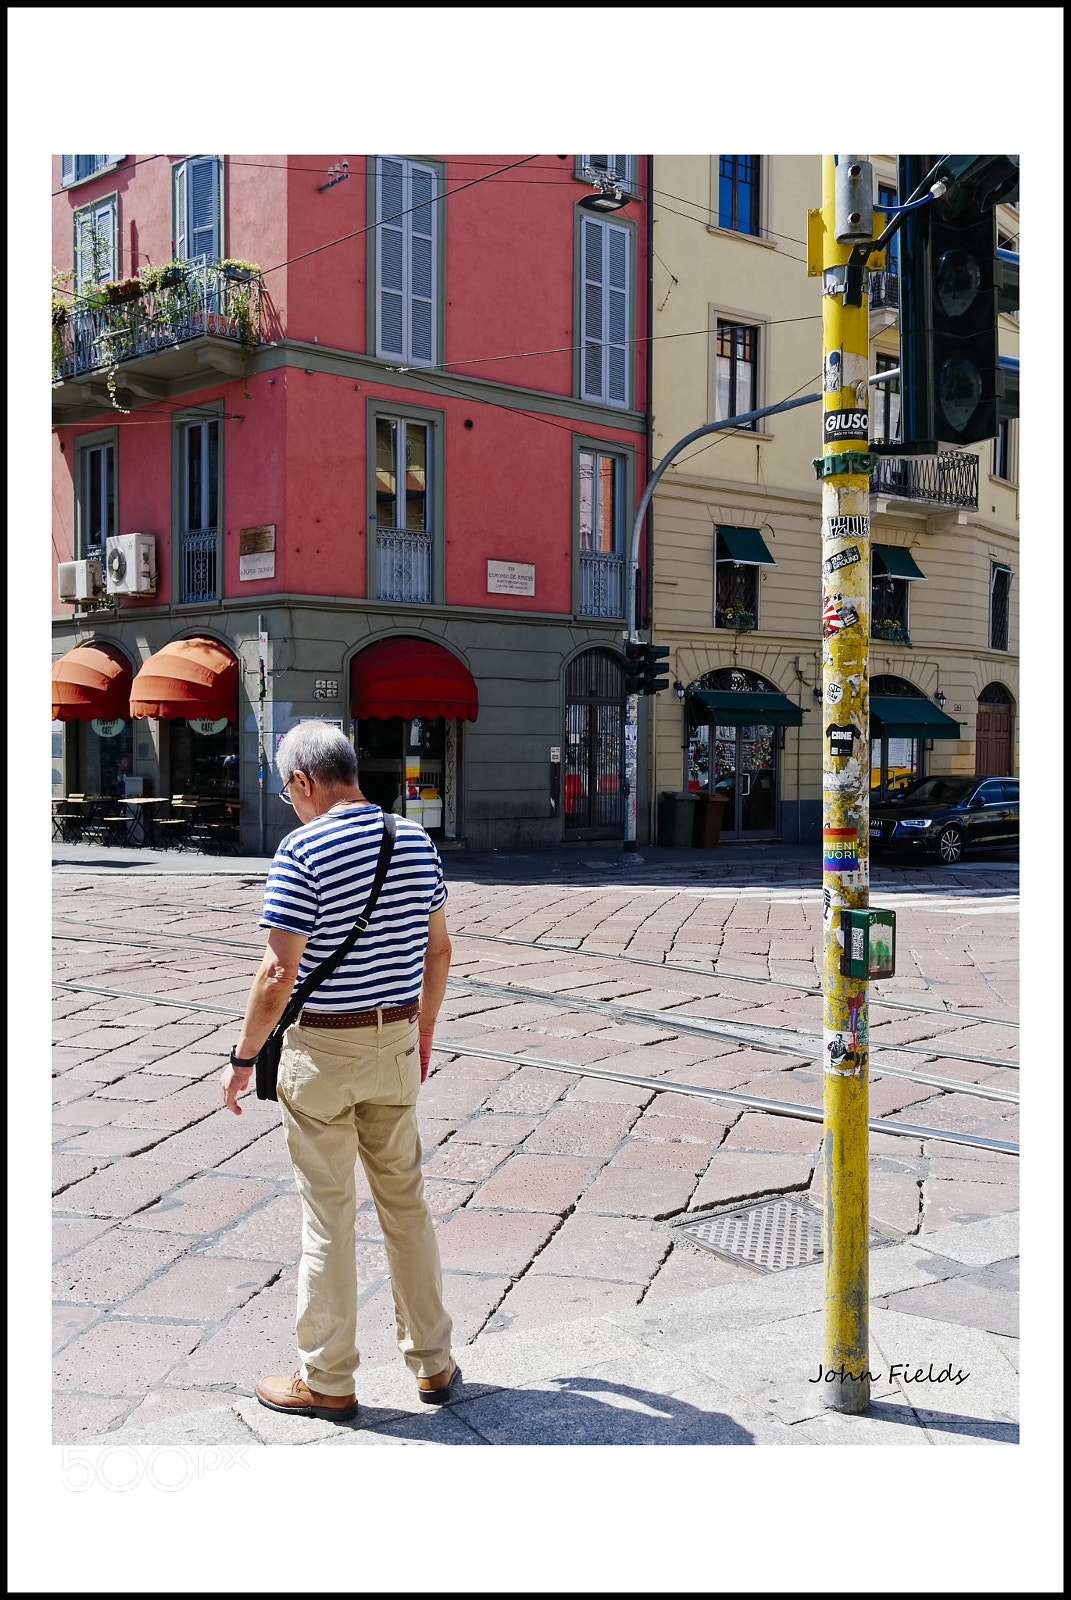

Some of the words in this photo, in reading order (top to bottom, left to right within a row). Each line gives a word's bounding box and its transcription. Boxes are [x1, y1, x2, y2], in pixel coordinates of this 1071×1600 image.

[826, 413, 869, 431] GIUSO
[831, 554, 843, 564] 2ND
[833, 554, 859, 570] GROUND
